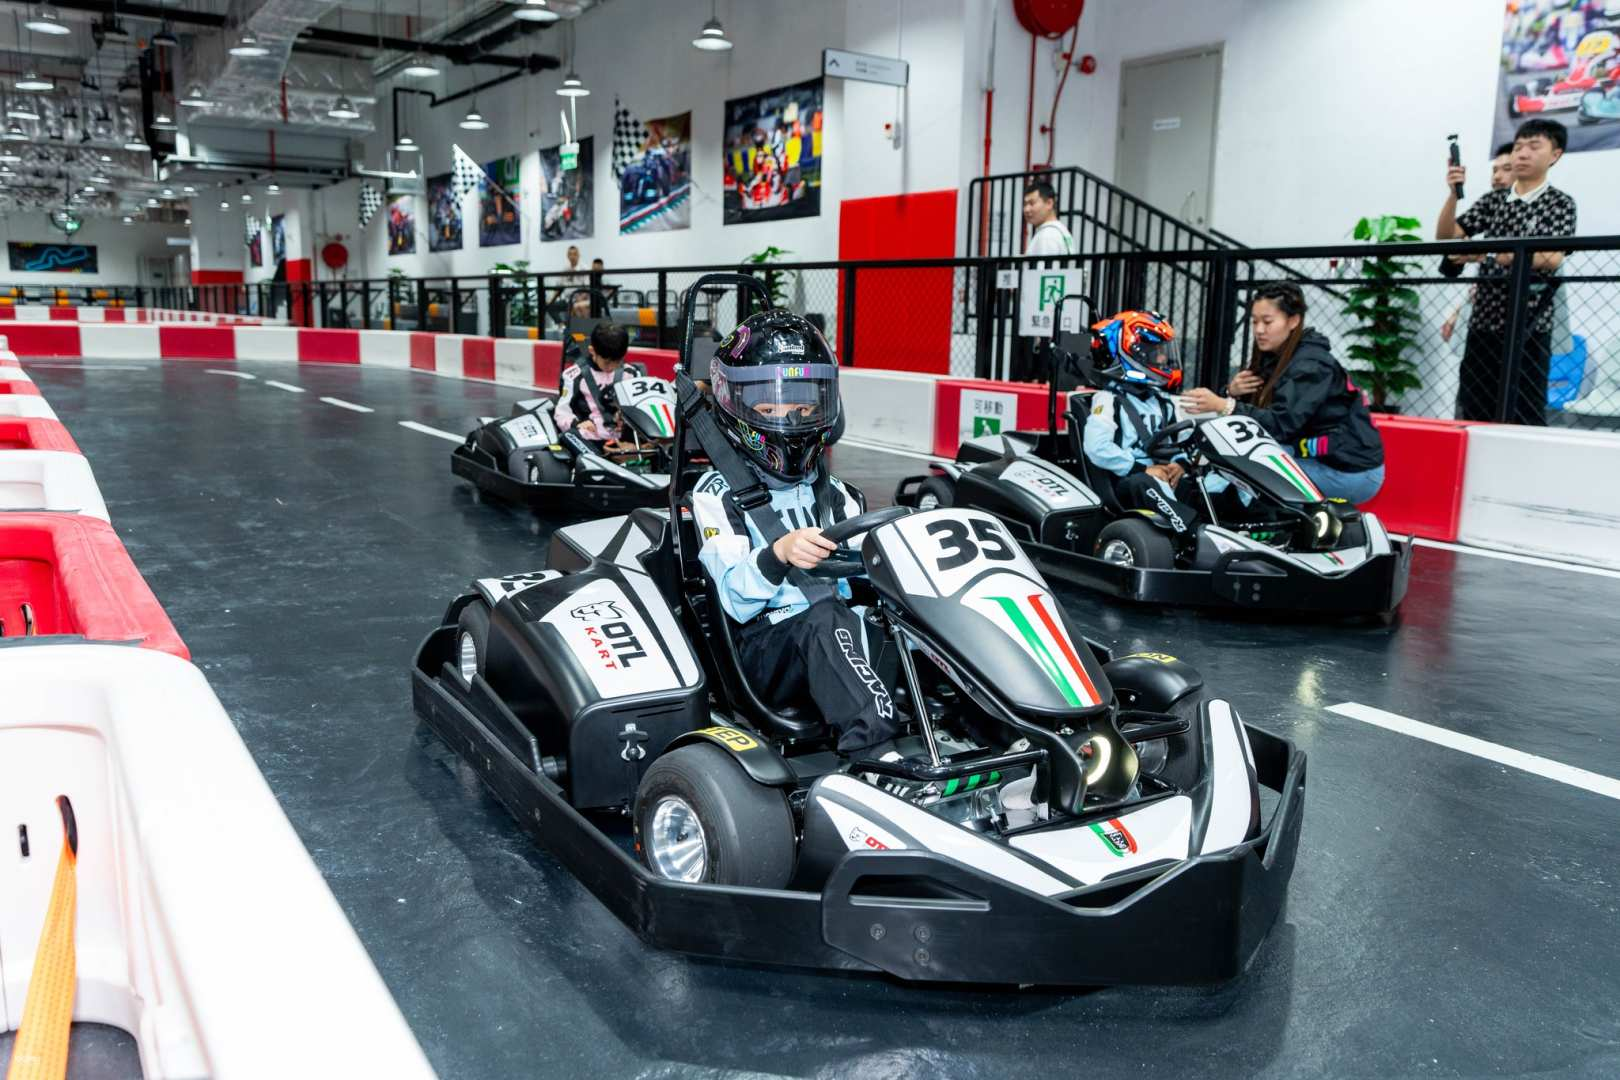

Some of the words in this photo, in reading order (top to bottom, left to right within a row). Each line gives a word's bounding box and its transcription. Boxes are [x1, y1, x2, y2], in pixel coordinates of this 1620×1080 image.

[632, 381, 667, 397] 34
[925, 518, 1016, 572] 35
[584, 626, 618, 670] KART
[600, 621, 648, 668] OTL
[834, 628, 893, 719] RACING
